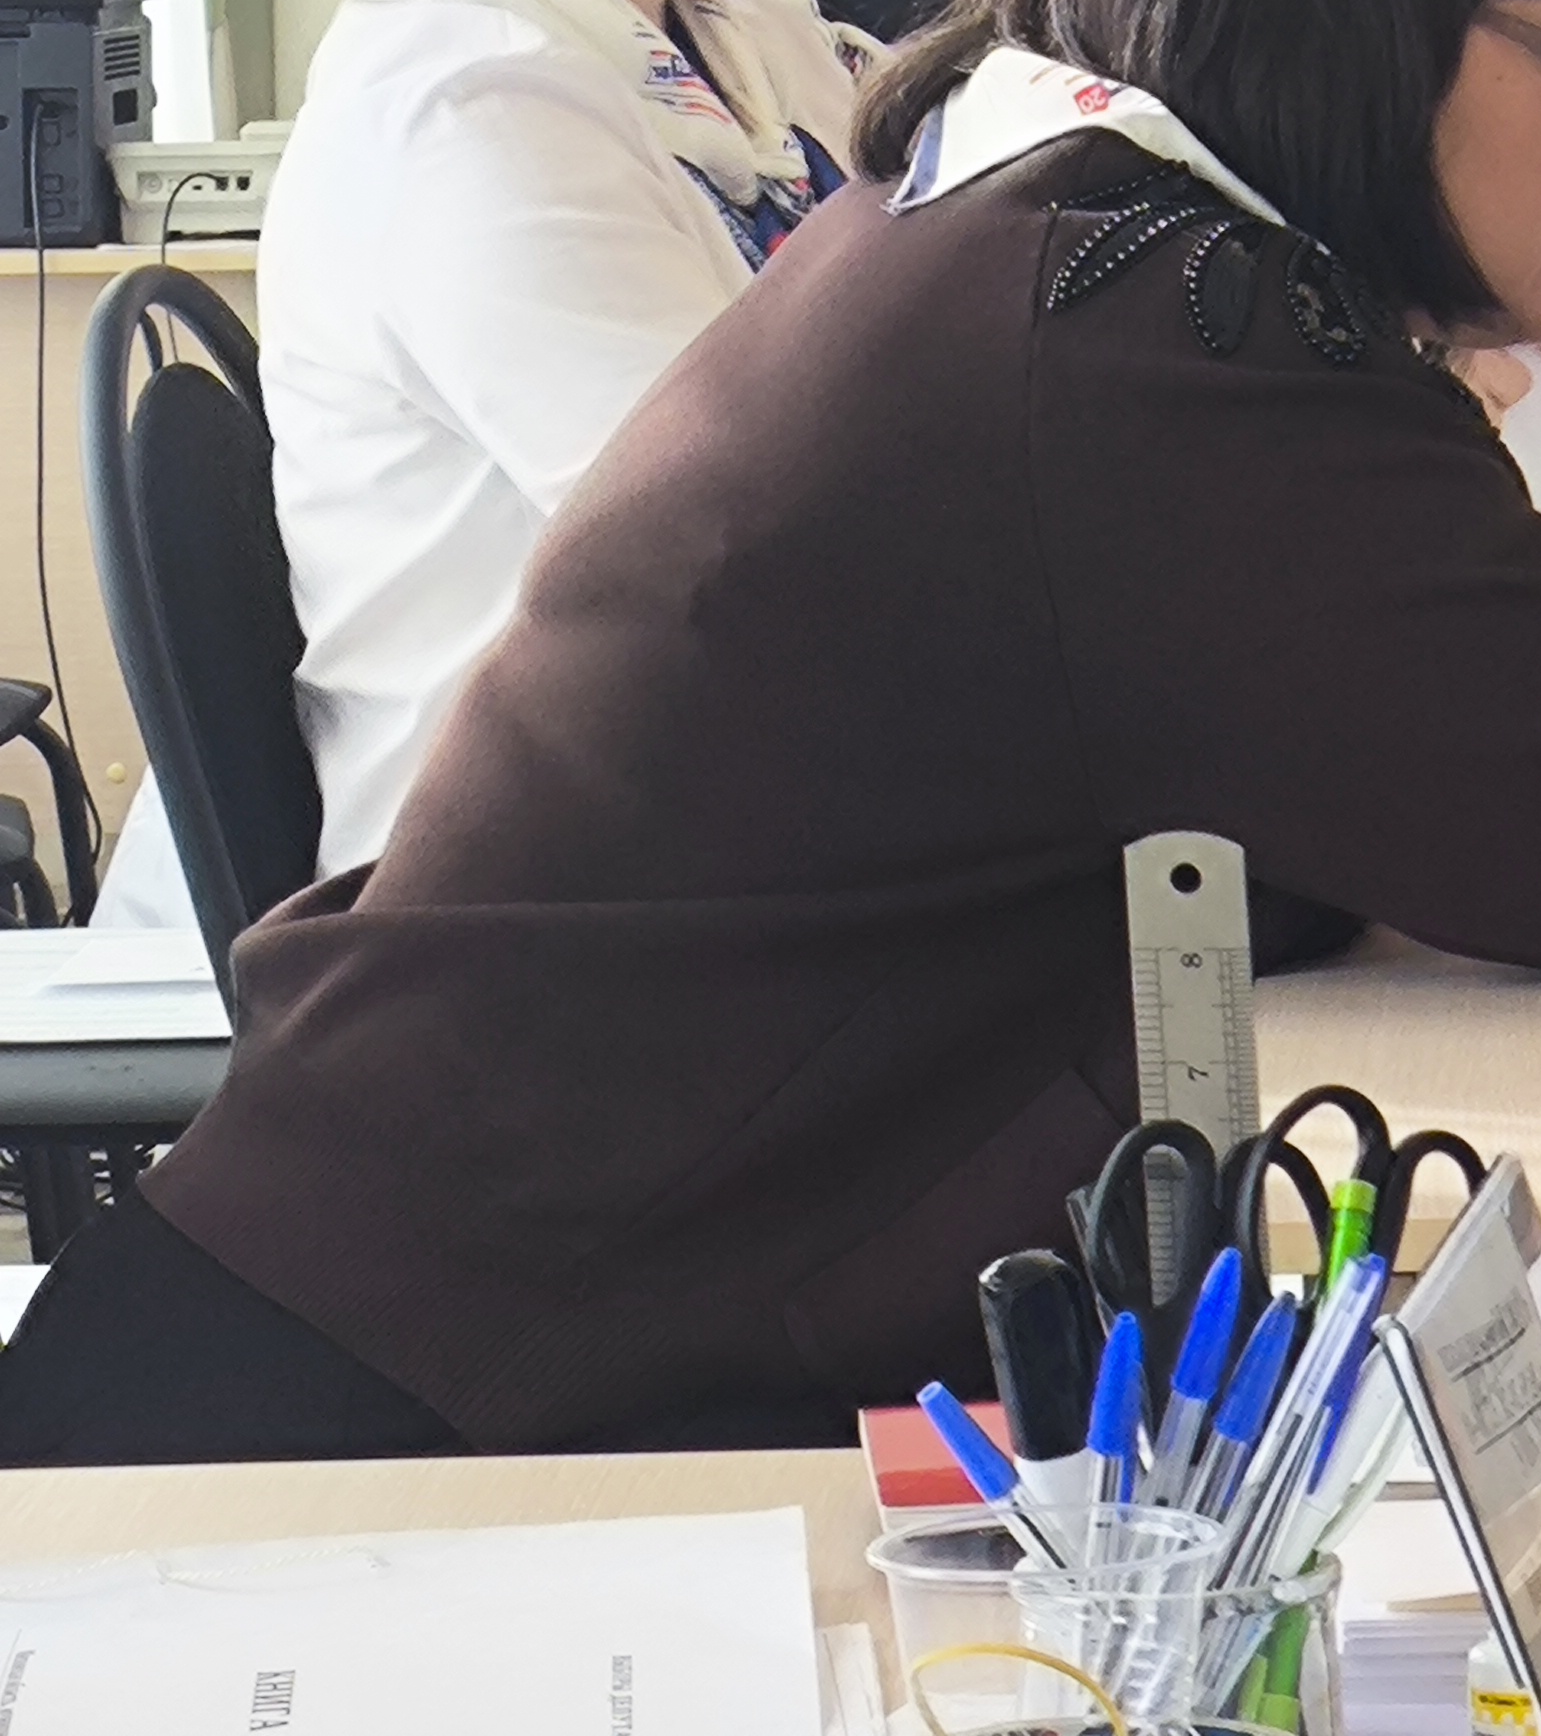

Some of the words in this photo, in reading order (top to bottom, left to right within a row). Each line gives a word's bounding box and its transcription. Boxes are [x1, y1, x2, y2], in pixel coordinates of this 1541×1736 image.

[1180, 951, 1203, 969] 8
[1186, 1065, 1209, 1082] 7
[249, 1669, 295, 1732] КНИГА
